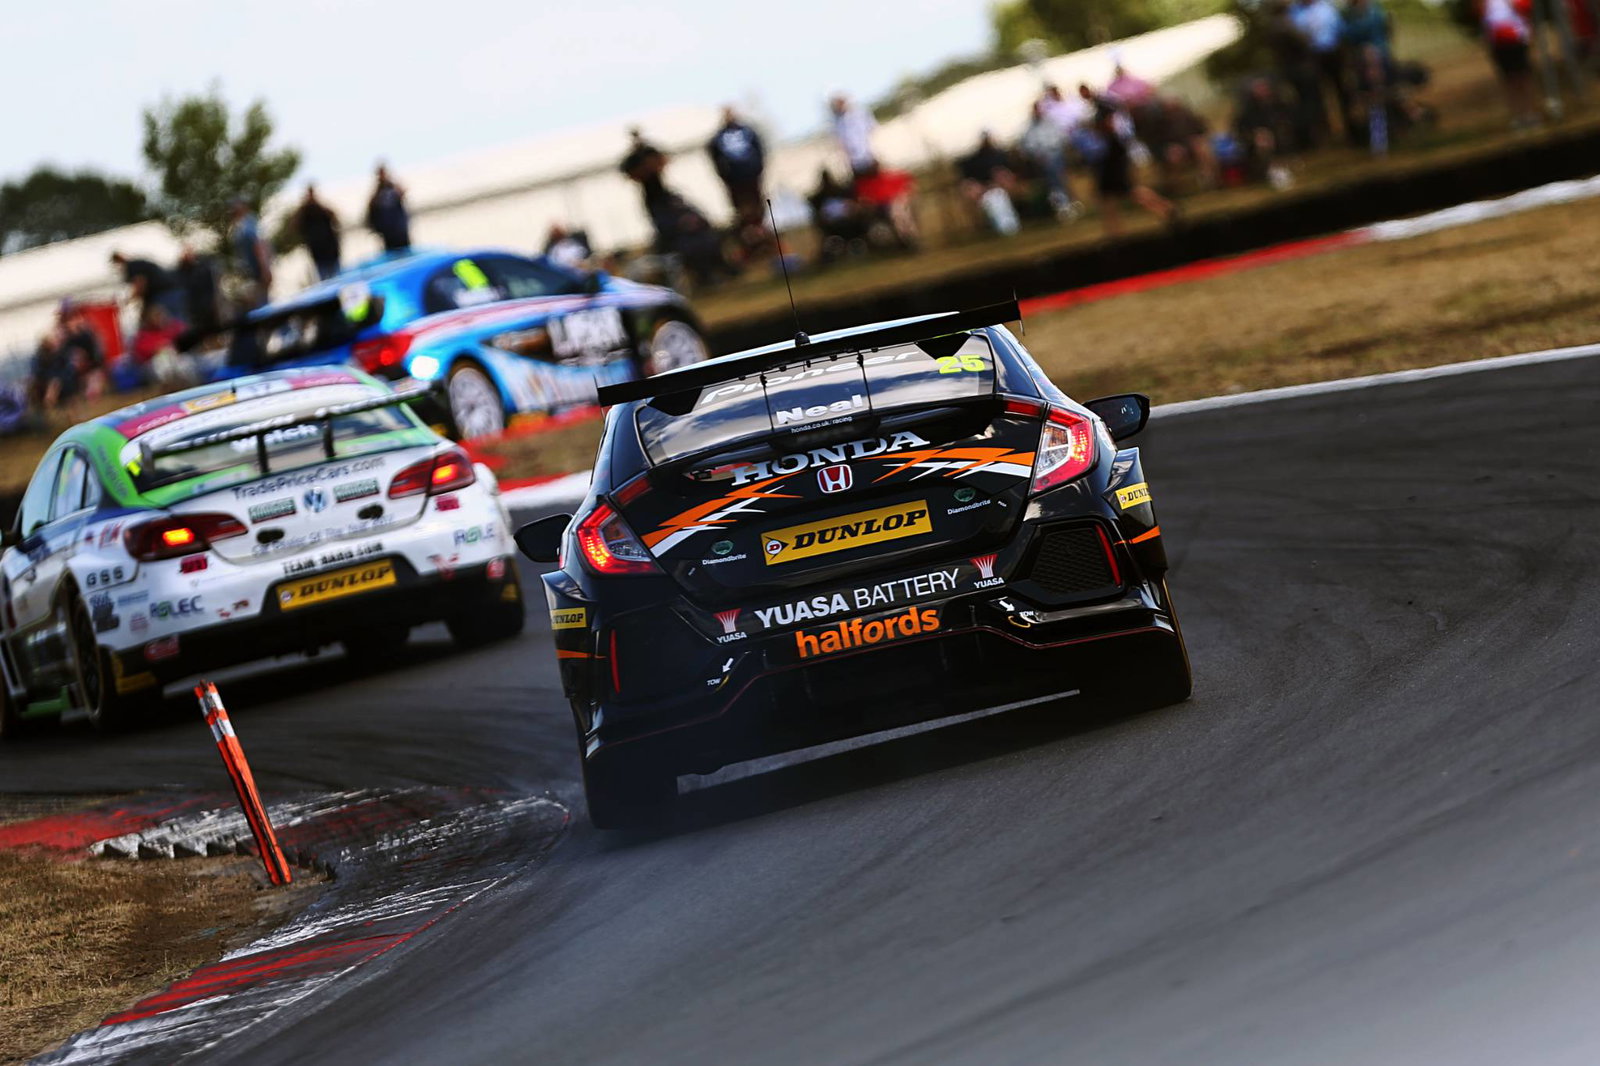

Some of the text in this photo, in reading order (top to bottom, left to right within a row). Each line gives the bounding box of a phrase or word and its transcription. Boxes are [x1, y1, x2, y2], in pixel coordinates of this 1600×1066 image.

[936, 354, 985, 374] 25
[775, 394, 863, 425] Neal
[731, 431, 930, 486] HONDA
[231, 456, 386, 500] TradePriceCars.com
[947, 499, 991, 515] Diamondbrite
[791, 509, 927, 550] DUNLOP
[702, 553, 747, 565] Diamondbrite
[300, 567, 391, 597] DUNLOP
[974, 577, 1005, 589] YUASA
[755, 568, 960, 628] YUASA BATTERY
[716, 631, 748, 644] YUASA
[794, 607, 940, 658] halfords
[706, 677, 721, 686] TOW
